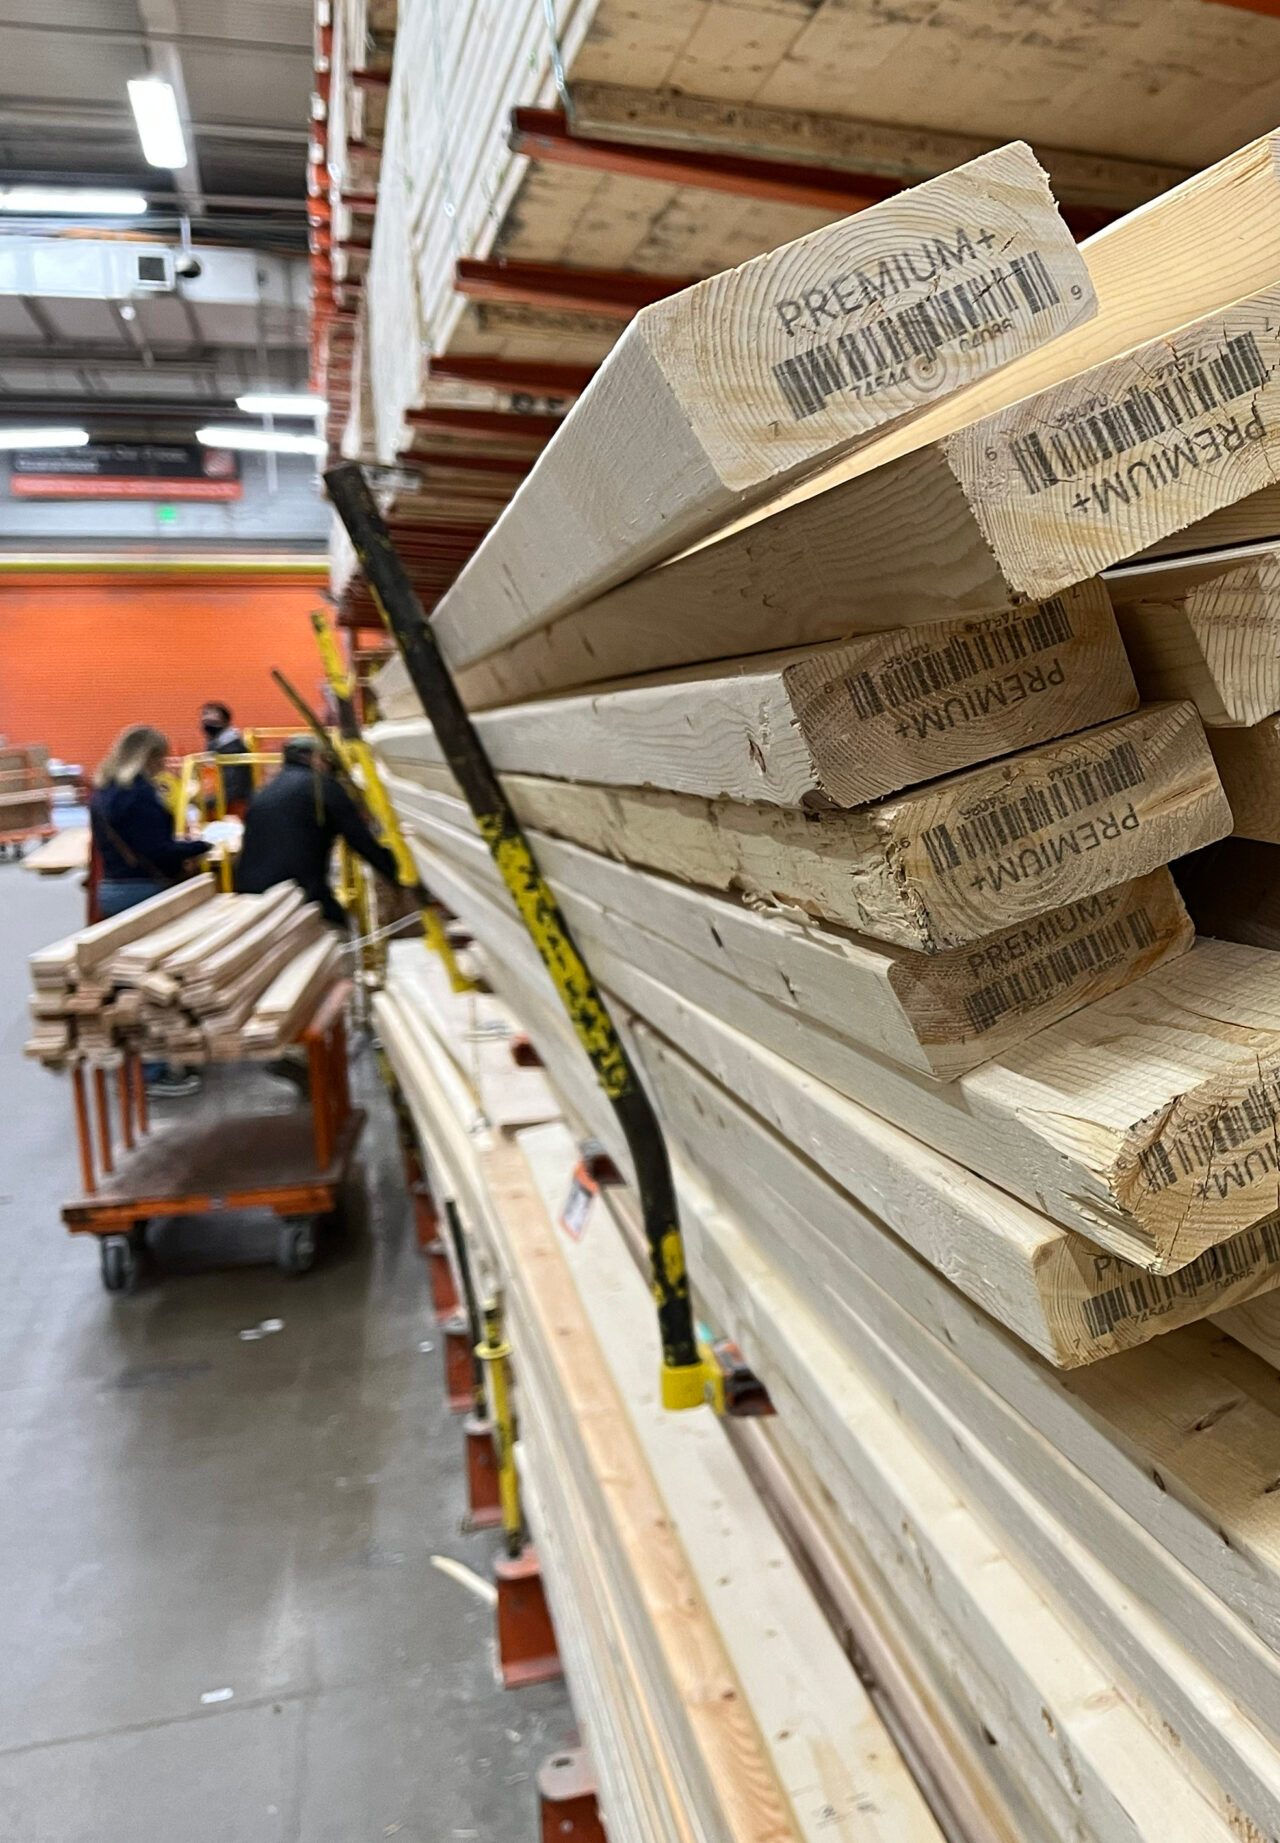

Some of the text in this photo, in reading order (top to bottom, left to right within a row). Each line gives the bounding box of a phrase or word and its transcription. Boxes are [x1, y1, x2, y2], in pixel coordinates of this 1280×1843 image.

[776, 226, 996, 338] PREMIUM+
[1070, 284, 1083, 301] 9
[1071, 413, 1267, 515] PREMIUM+
[894, 658, 1066, 741] PREMIUM+
[969, 802, 1141, 893] PREMIUM+
[965, 894, 1121, 979] PREMIUM+
